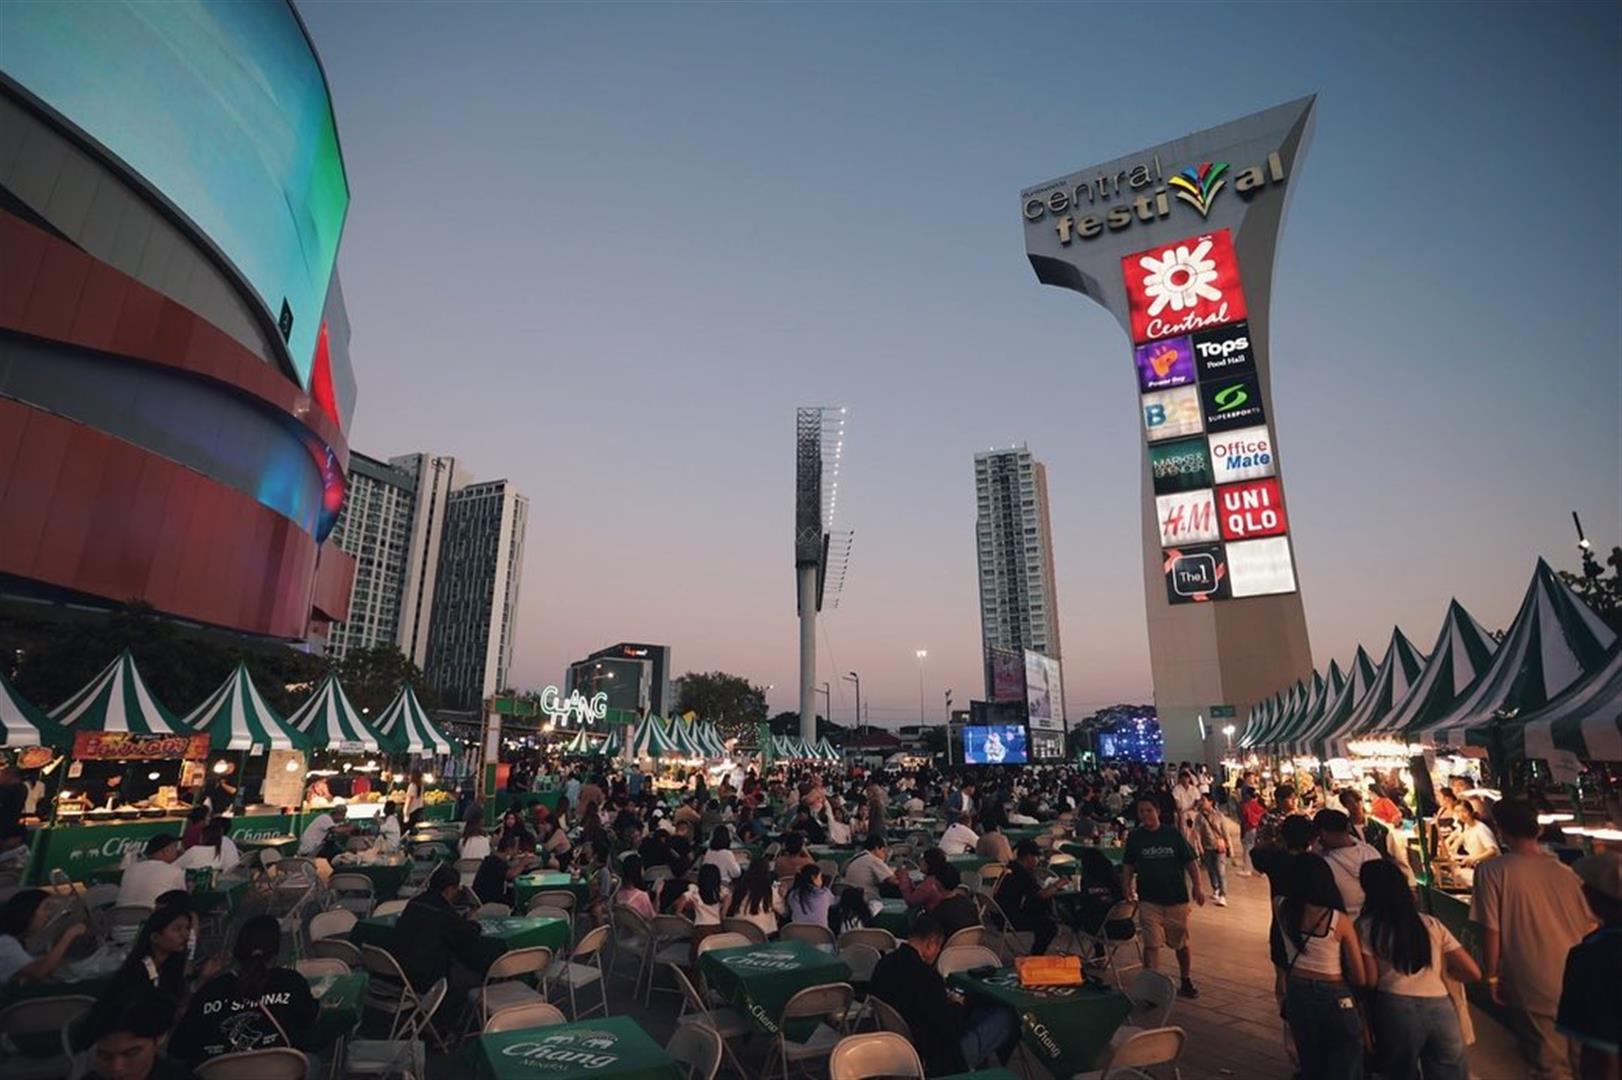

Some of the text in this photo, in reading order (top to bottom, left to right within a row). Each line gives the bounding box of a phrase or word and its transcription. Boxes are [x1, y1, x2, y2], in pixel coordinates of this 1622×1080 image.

[1022, 151, 1164, 221] central
[1146, 301, 1231, 339] Central
[1196, 336, 1250, 358] Tops
[1207, 407, 1261, 423] SUPERSPORTS
[1213, 440, 1268, 458] Office
[1226, 453, 1271, 471] Mate
[1224, 487, 1270, 511] UNI
[1228, 510, 1278, 536] QLO
[540, 684, 608, 727] CHANG
[721, 955, 803, 971] Chang
[1031, 1023, 1063, 1059] Chang
[501, 1042, 619, 1069] Chang
